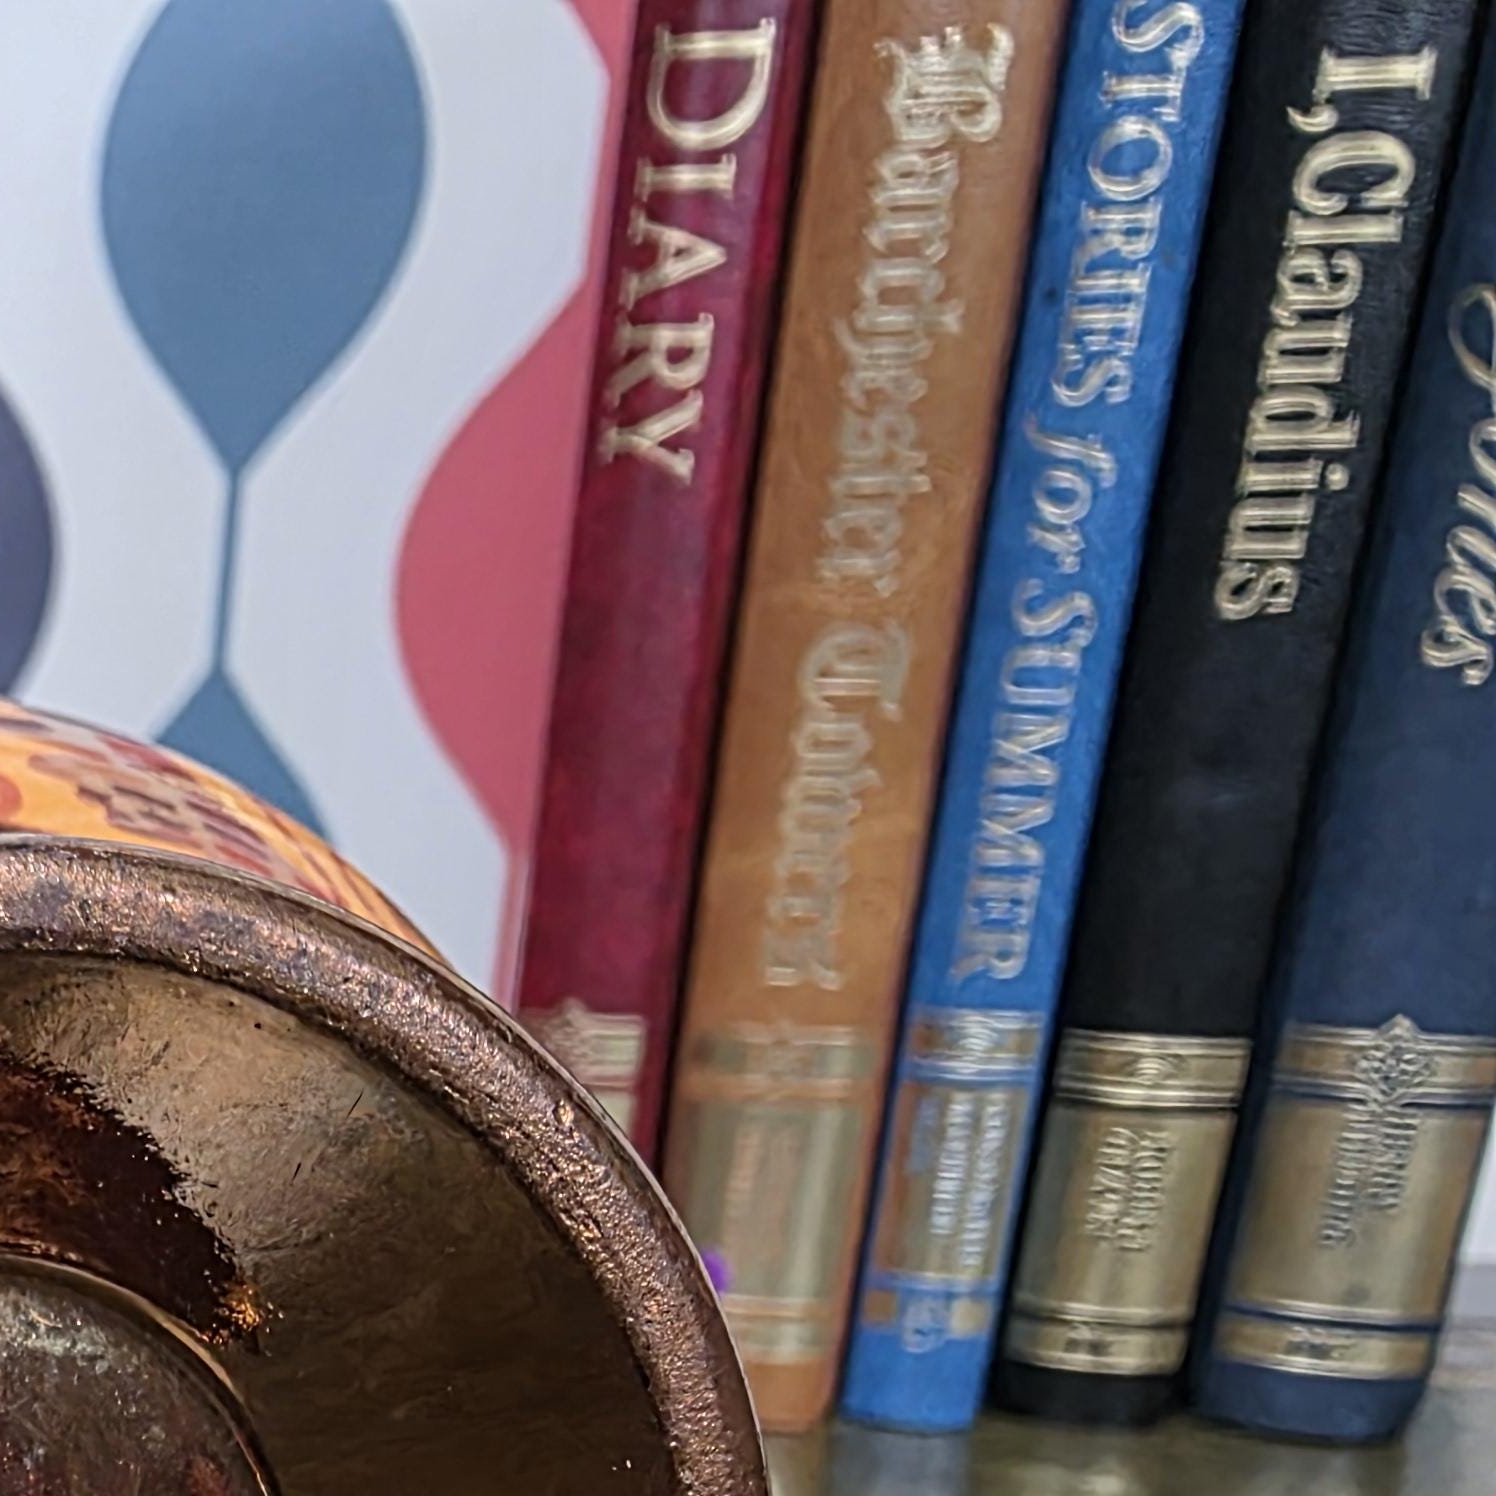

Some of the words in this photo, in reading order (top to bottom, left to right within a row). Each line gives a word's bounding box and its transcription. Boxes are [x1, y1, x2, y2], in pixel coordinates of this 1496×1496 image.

[598, 17, 777, 487] DIARY
[814, 22, 1015, 597] Barchester
[1051, 0, 1204, 407] STORIES
[1023, 408, 1118, 575] for
[950, 577, 1099, 981] SUMMER
